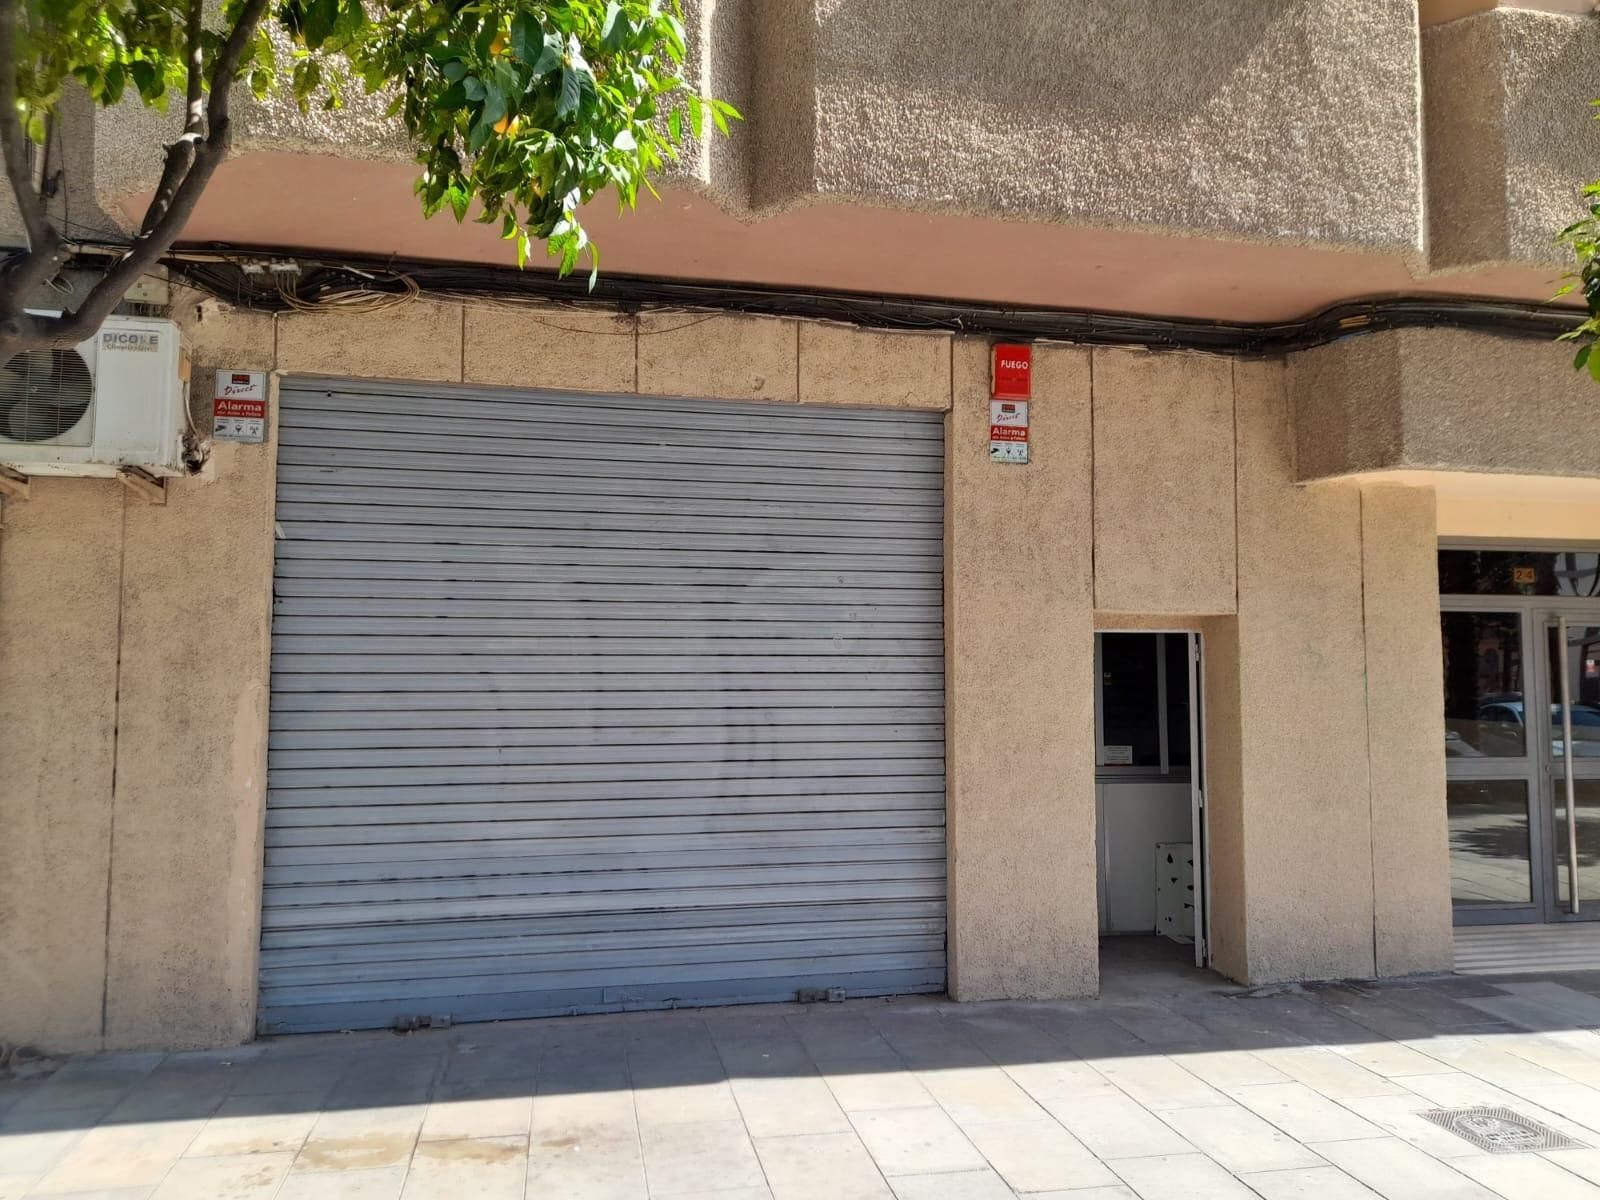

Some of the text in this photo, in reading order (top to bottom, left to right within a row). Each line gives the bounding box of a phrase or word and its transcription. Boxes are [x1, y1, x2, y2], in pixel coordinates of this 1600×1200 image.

[1001, 359, 1029, 370] FUEGO
[217, 400, 262, 412] Alarma
[992, 426, 1026, 437] Alarma
